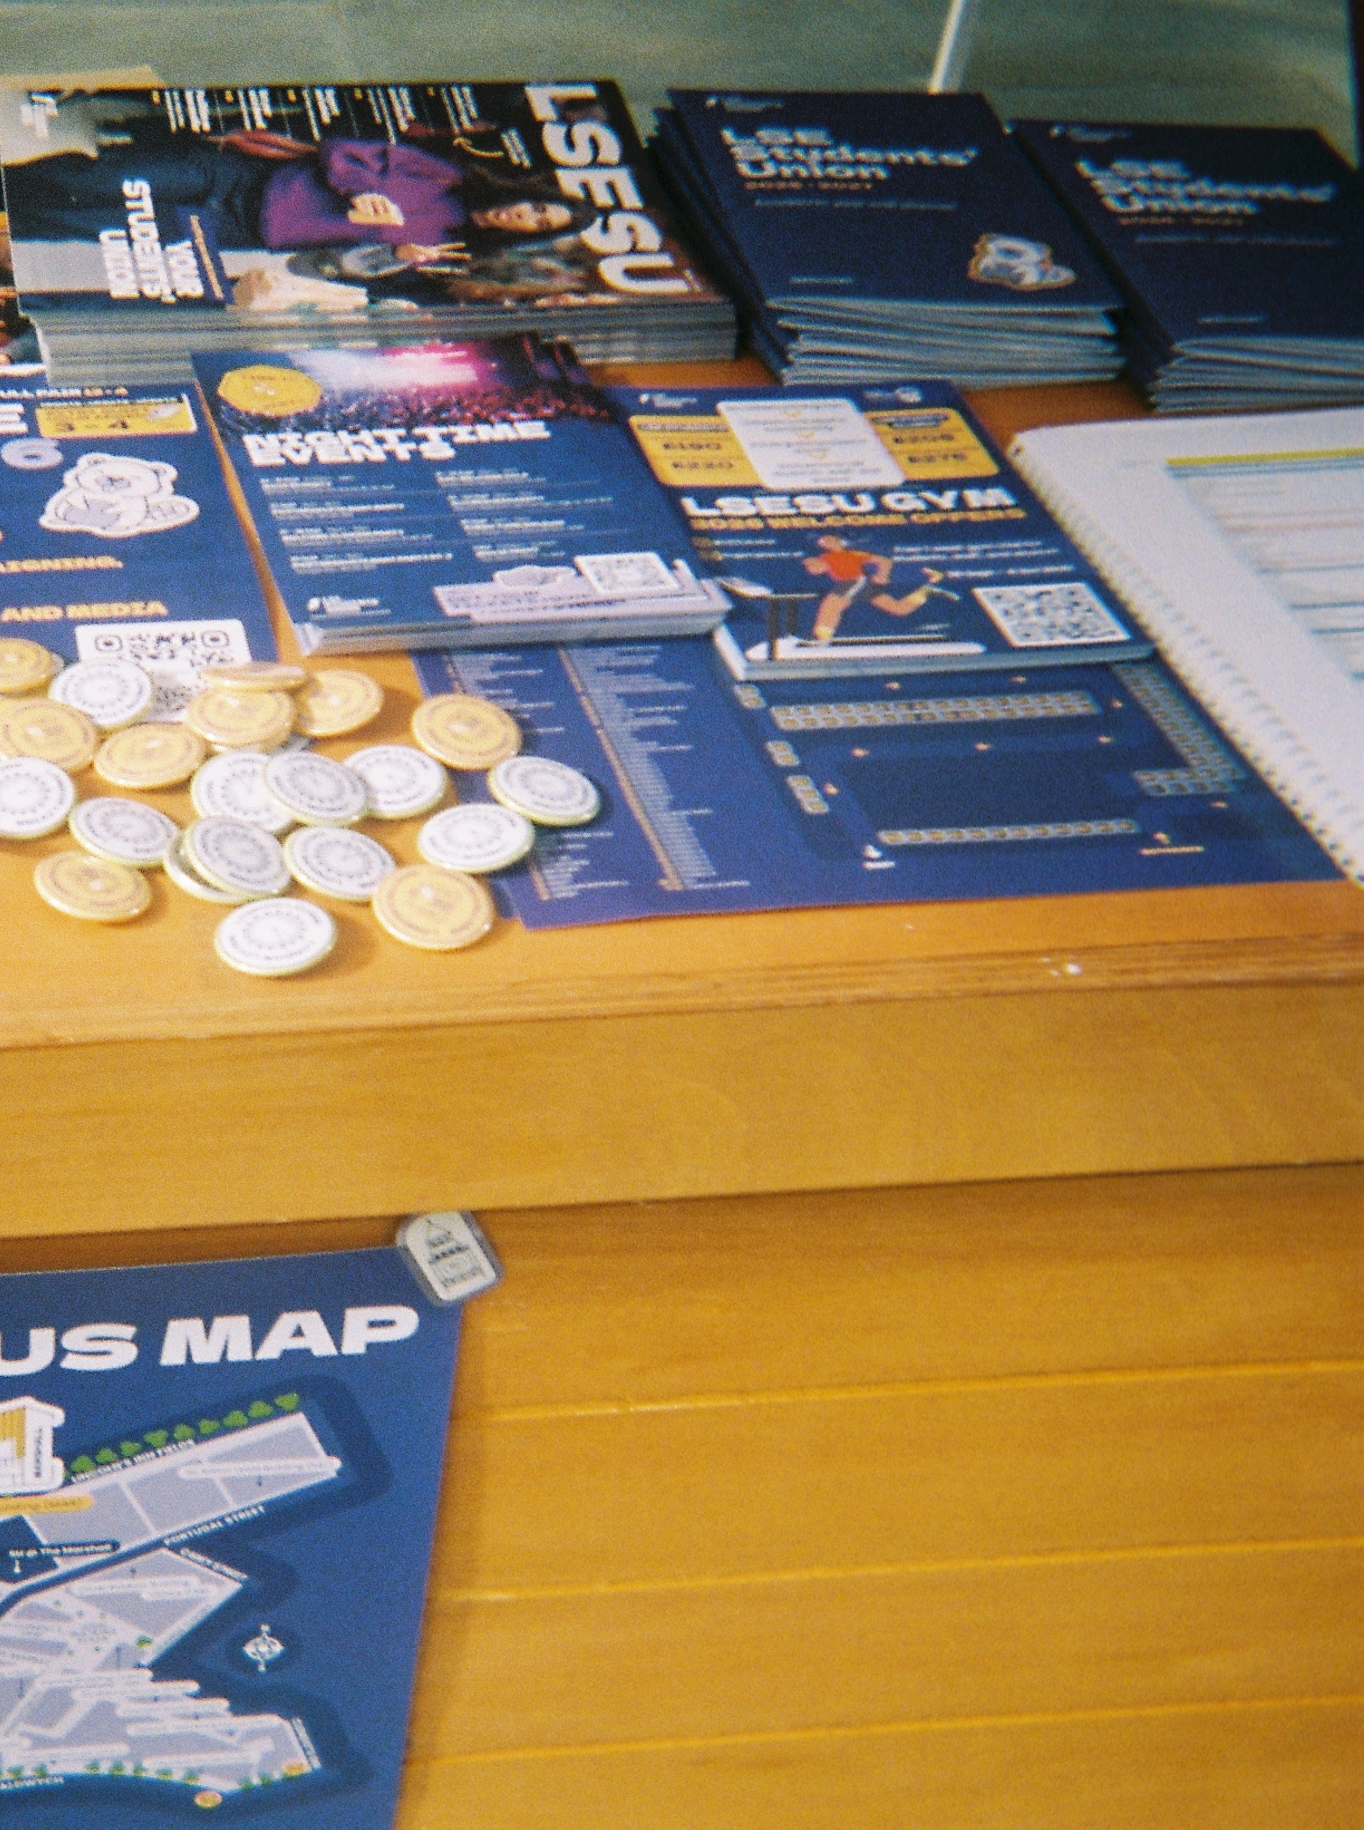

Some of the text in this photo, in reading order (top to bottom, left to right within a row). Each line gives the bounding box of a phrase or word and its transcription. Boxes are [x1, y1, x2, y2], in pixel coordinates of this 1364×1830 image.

[525, 83, 690, 293] LSESU
[99, 229, 140, 299] UNION
[166, 240, 204, 298] YOUR
[681, 485, 1019, 519] LSESU GYM
[0, 605, 64, 623] AND
[65, 601, 169, 621] MEDIA
[160, 1304, 420, 1369] MAP
